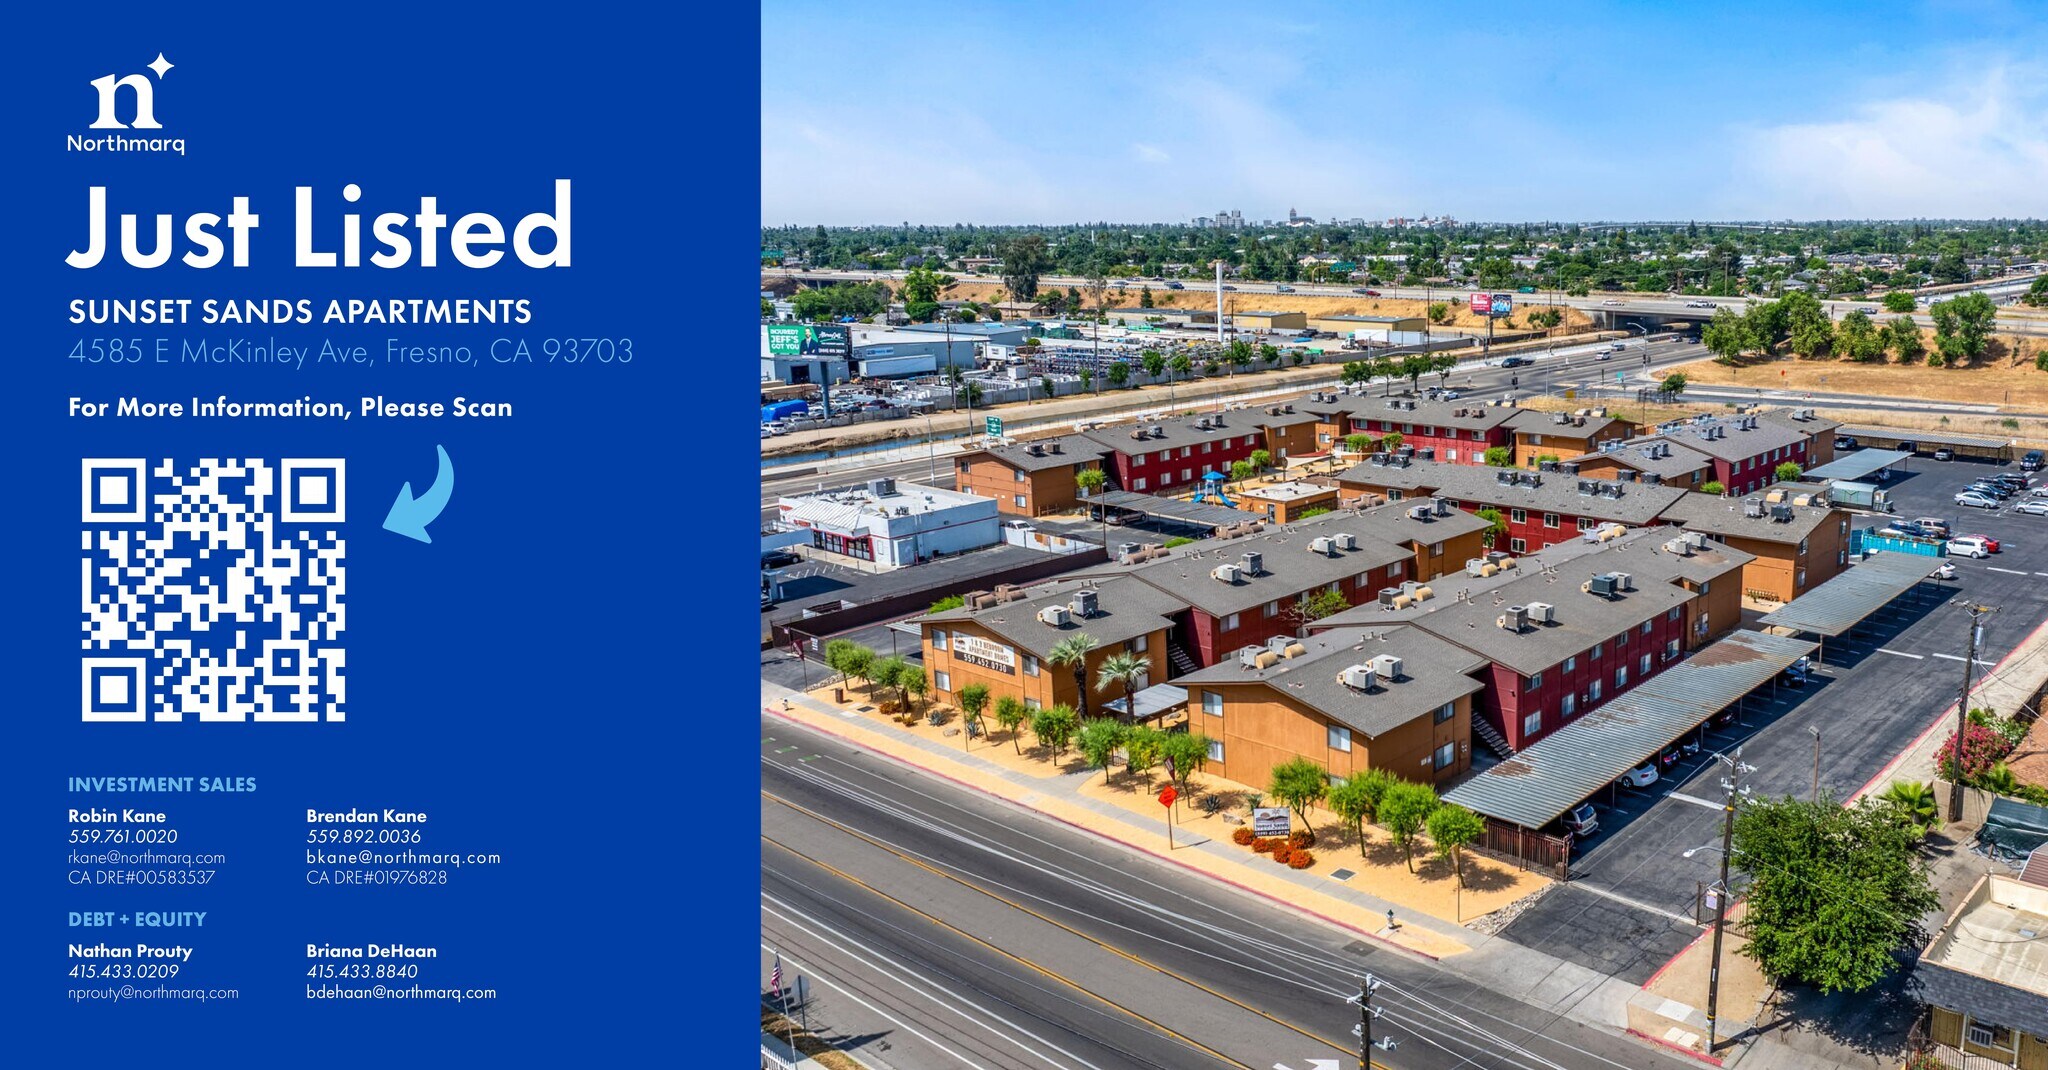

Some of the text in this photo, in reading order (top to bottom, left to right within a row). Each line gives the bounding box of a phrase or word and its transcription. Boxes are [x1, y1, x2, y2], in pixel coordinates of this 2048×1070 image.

[771, 335, 799, 343] JEFF'S
[969, 645, 993, 659] APARTMENT
[963, 653, 1007, 673] 559.452.0730
